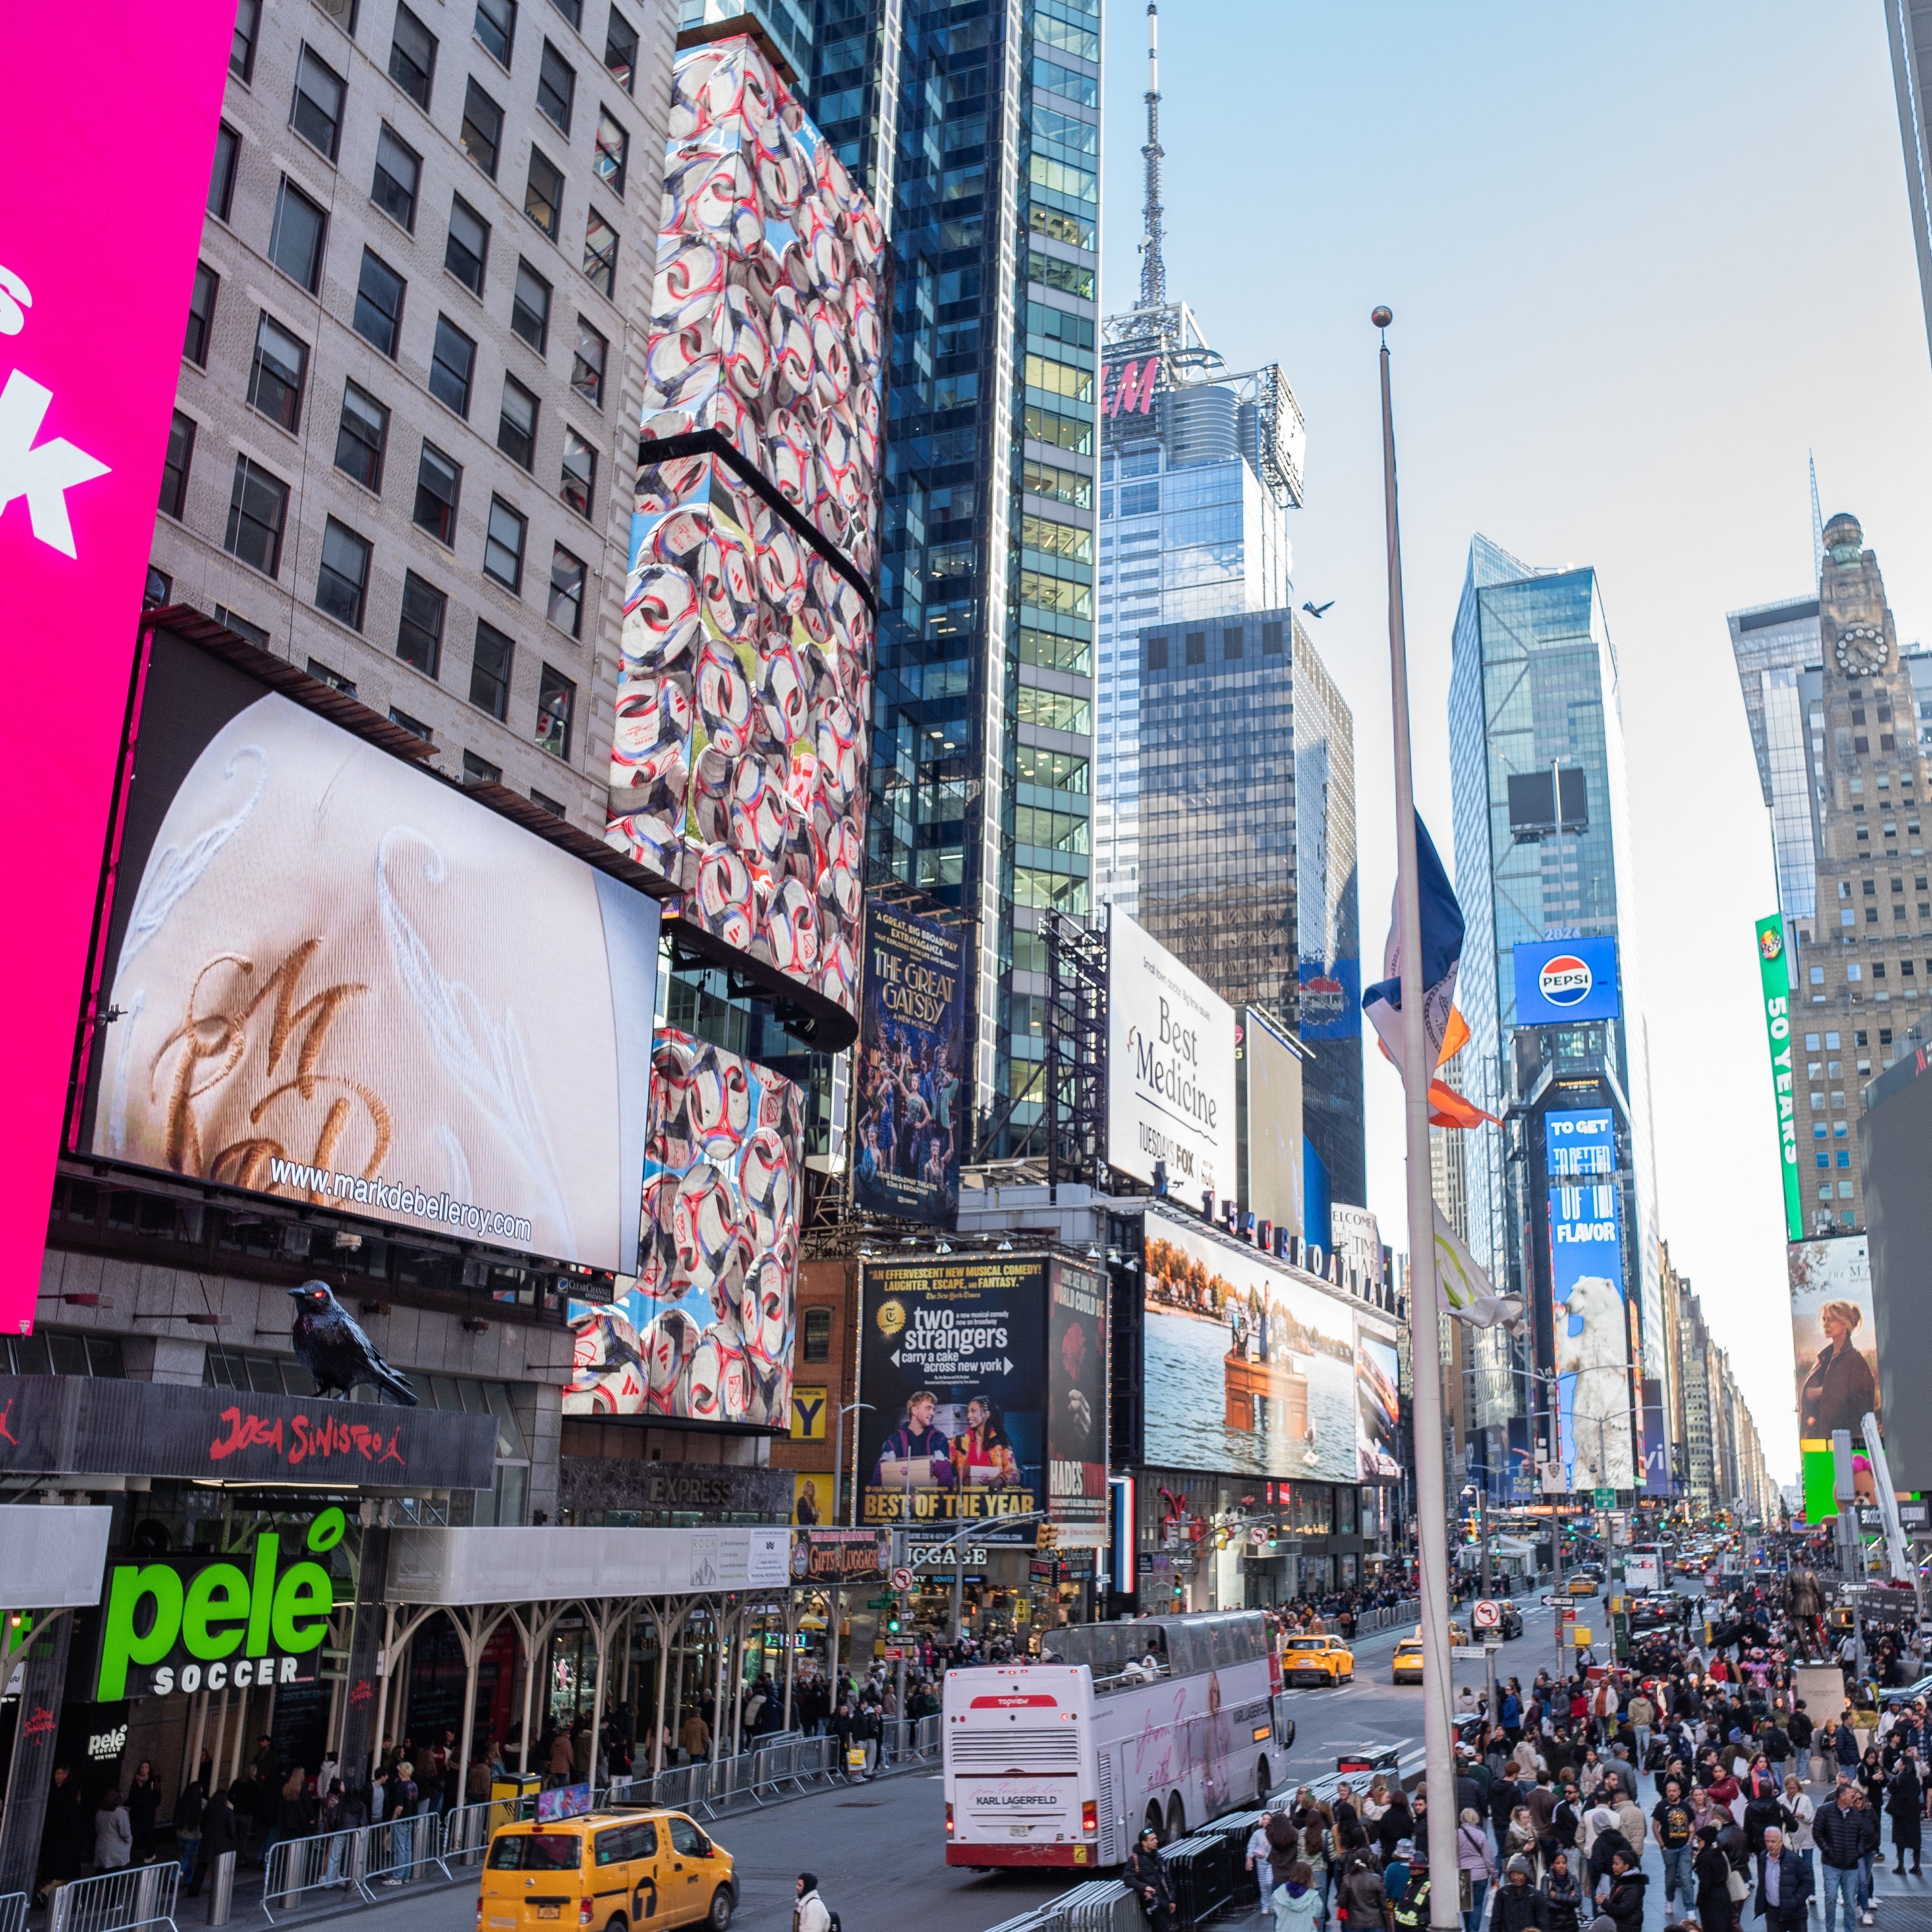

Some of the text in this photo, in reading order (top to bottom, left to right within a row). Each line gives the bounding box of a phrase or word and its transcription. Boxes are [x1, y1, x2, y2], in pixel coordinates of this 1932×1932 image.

[883, 914, 907, 932] GREAT,
[908, 924, 920, 937] BIG
[922, 930, 958, 952] BROADWAY
[891, 928, 943, 957] EXTRAVAGANZA
[876, 950, 956, 1003] THE GREAT
[1543, 974, 1588, 986] PEPSI
[882, 981, 945, 1024] GATSBY
[911, 1020, 936, 1034] MUSICAL
[1768, 995, 1789, 1040] 50
[1159, 995, 1197, 1067] Best
[1136, 1031, 1217, 1129] Medicine
[1551, 1119, 1609, 1136] TO GET
[1139, 1121, 1194, 1178] TUESDAYS FOX
[890, 1173, 917, 1186] BROADWAY
[917, 1180, 938, 1192] THEATRE
[903, 1183, 929, 1196] BROADWAY
[270, 1156, 532, 1242] www.markdebelleroy.com
[1557, 1222, 1616, 1243] FLAVOR
[884, 1280, 931, 1292] LAUGHTER,
[932, 1279, 967, 1290] ESCAPE,
[978, 1276, 1025, 1289] FANTASY."
[885, 1267, 944, 1280] EFFERVESCENT
[945, 1267, 965, 1278] NEW
[966, 1265, 1002, 1277] MUSICAL
[1003, 1264, 1042, 1276] COMEDY!
[937, 1292, 949, 1300] New
[950, 1292, 963, 1301] York
[1075, 1290, 1096, 1315] COULD
[913, 1306, 954, 1330] two
[990, 1310, 1009, 1319] comedy
[905, 1327, 1008, 1355] strangers
[901, 1350, 959, 1365] carry a cake
[923, 1358, 1002, 1374] across new york
[793, 1398, 825, 1436] Y
[650, 1476, 733, 1504] EXPRESS
[864, 1494, 912, 1518] BEST
[915, 1494, 939, 1517] OF
[943, 1494, 980, 1517] THE
[984, 1493, 1035, 1517] YEAR
[692, 1539, 715, 1548] ROCK
[809, 1545, 836, 1574] GIFTS
[840, 1545, 879, 1573] LUGGAGE
[97, 1506, 346, 1703] pelé
[153, 1657, 298, 1696] SOCCER
[88, 1724, 128, 1756] pelé
[95, 1746, 121, 1754] SOCCER
[976, 1795, 1057, 1805] KARL LAGERFELD
